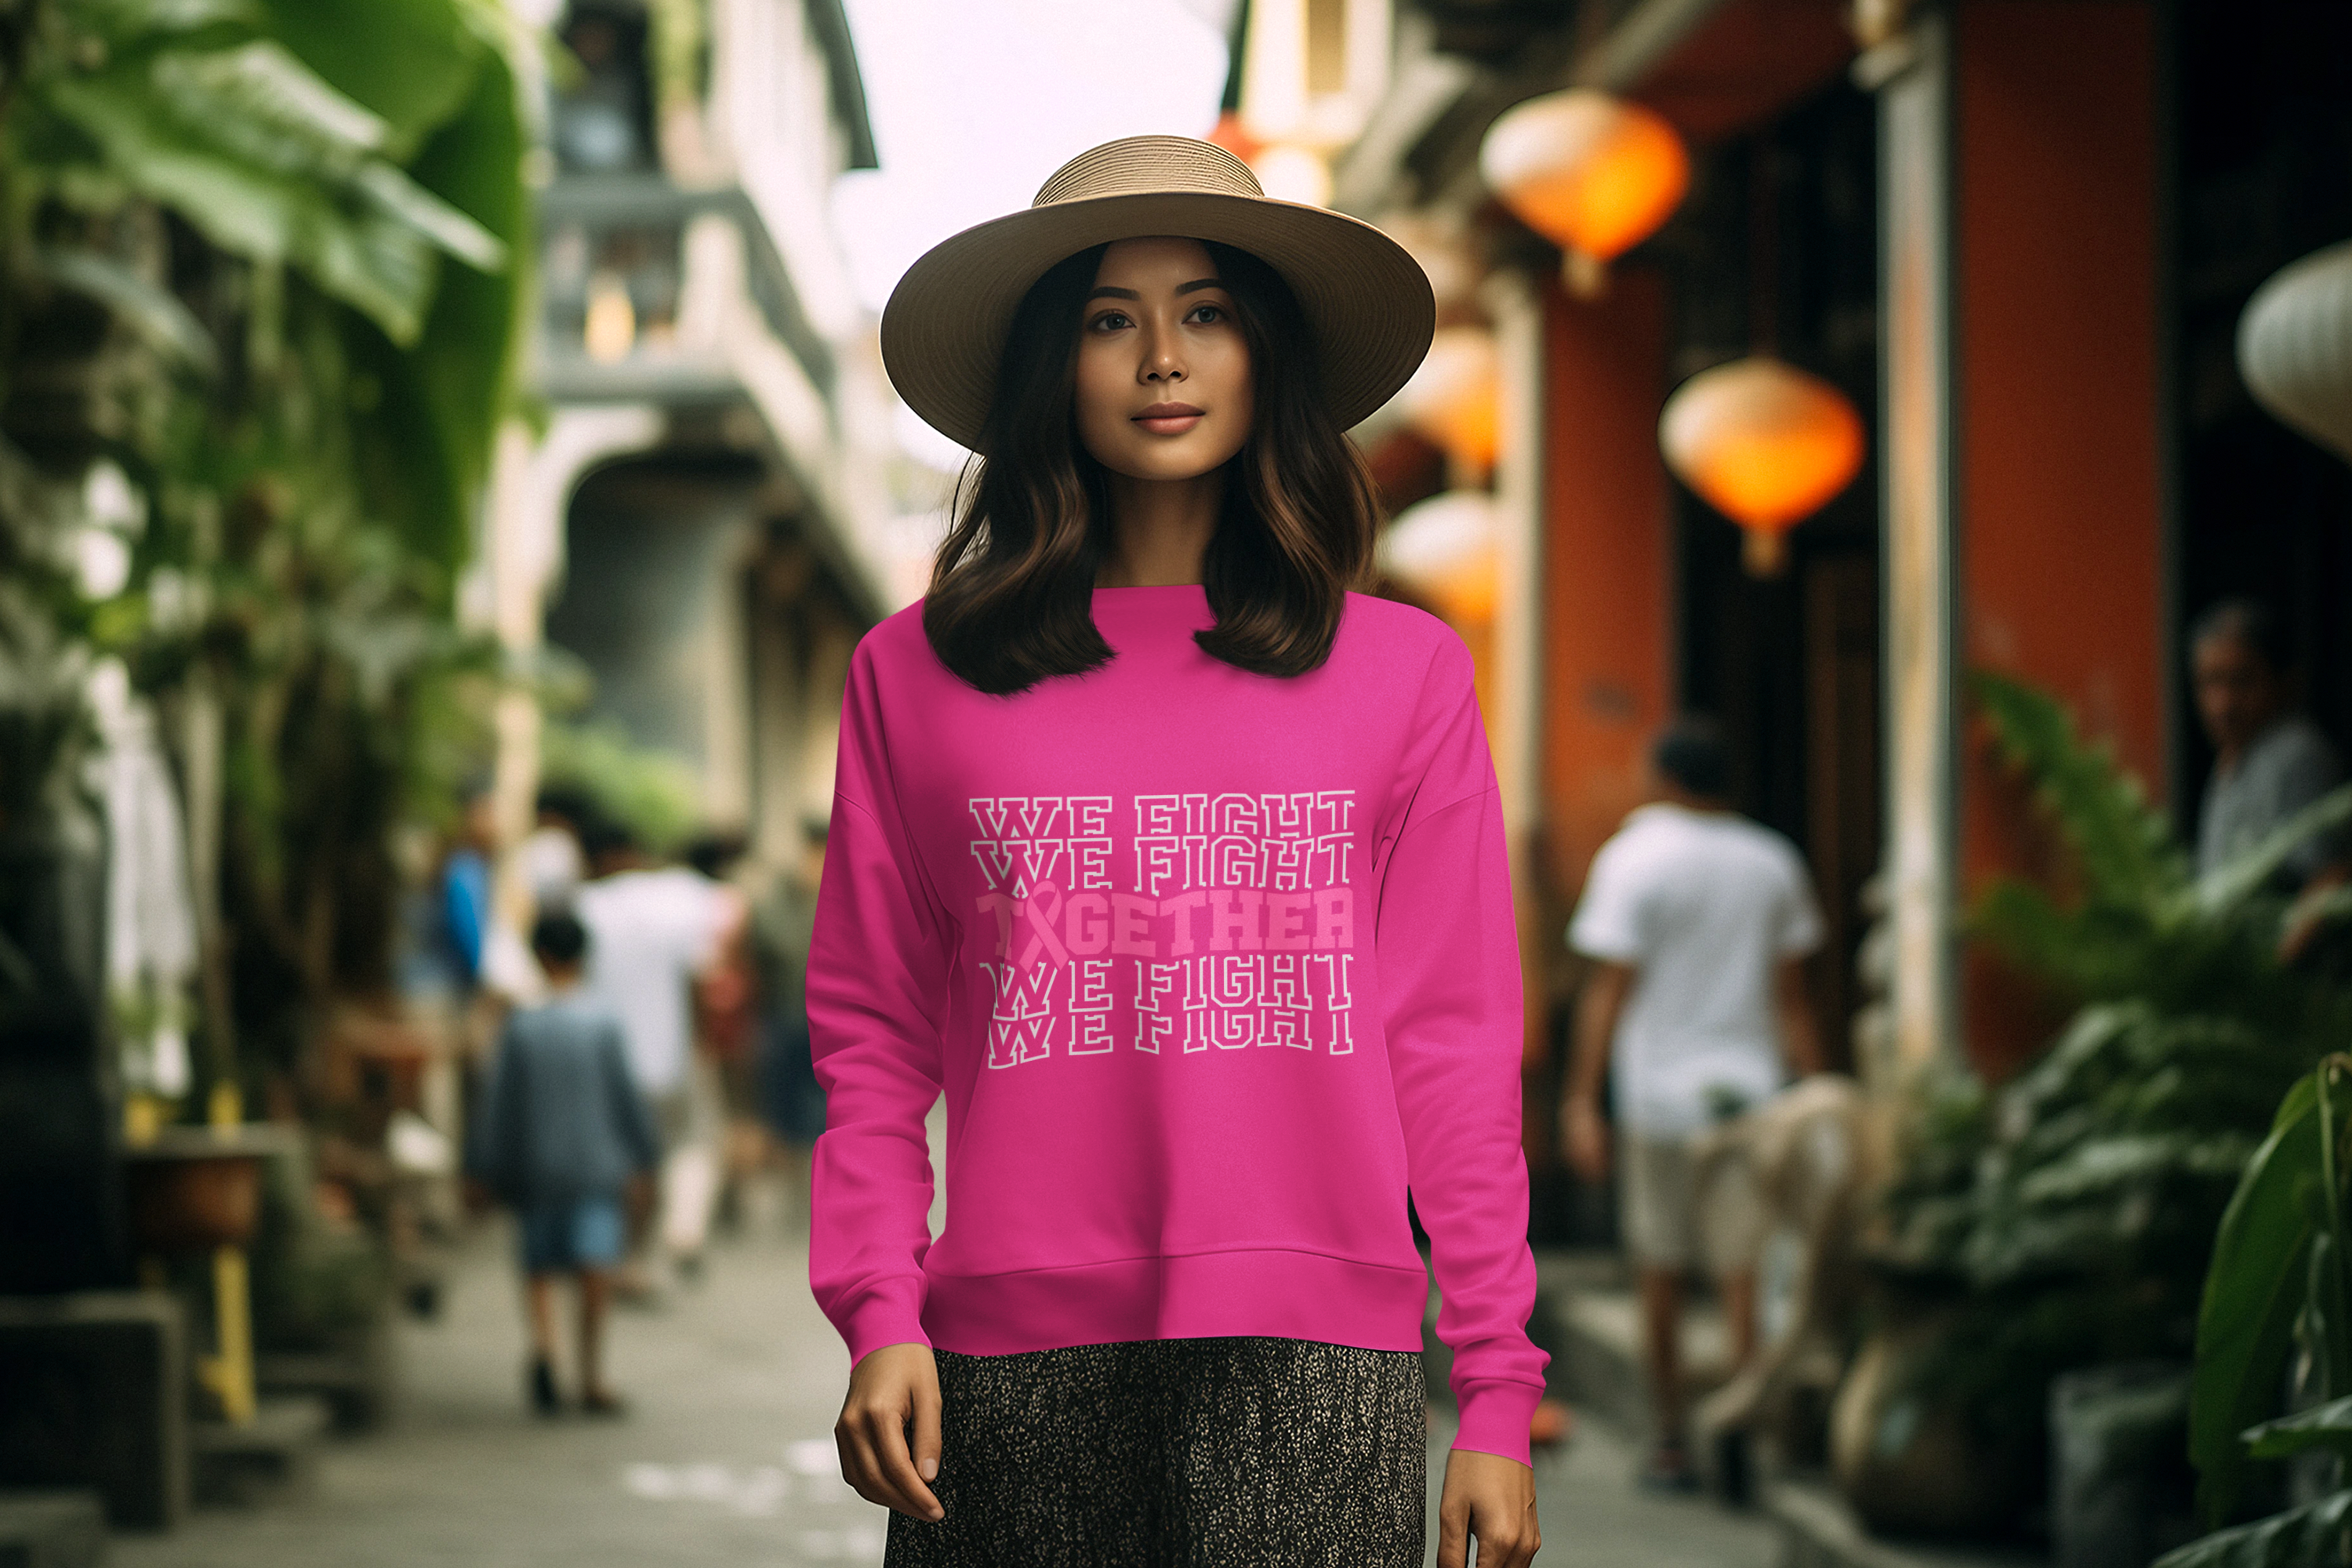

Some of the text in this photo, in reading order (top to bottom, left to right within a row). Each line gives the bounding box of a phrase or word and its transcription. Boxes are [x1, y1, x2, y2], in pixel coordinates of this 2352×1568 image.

[969, 789, 1356, 838] WE FIGHT
[971, 831, 1355, 899] WE FIGHT
[978, 953, 1354, 1021] WE FIGHT
[987, 1008, 1353, 1069] WE FIGHT
